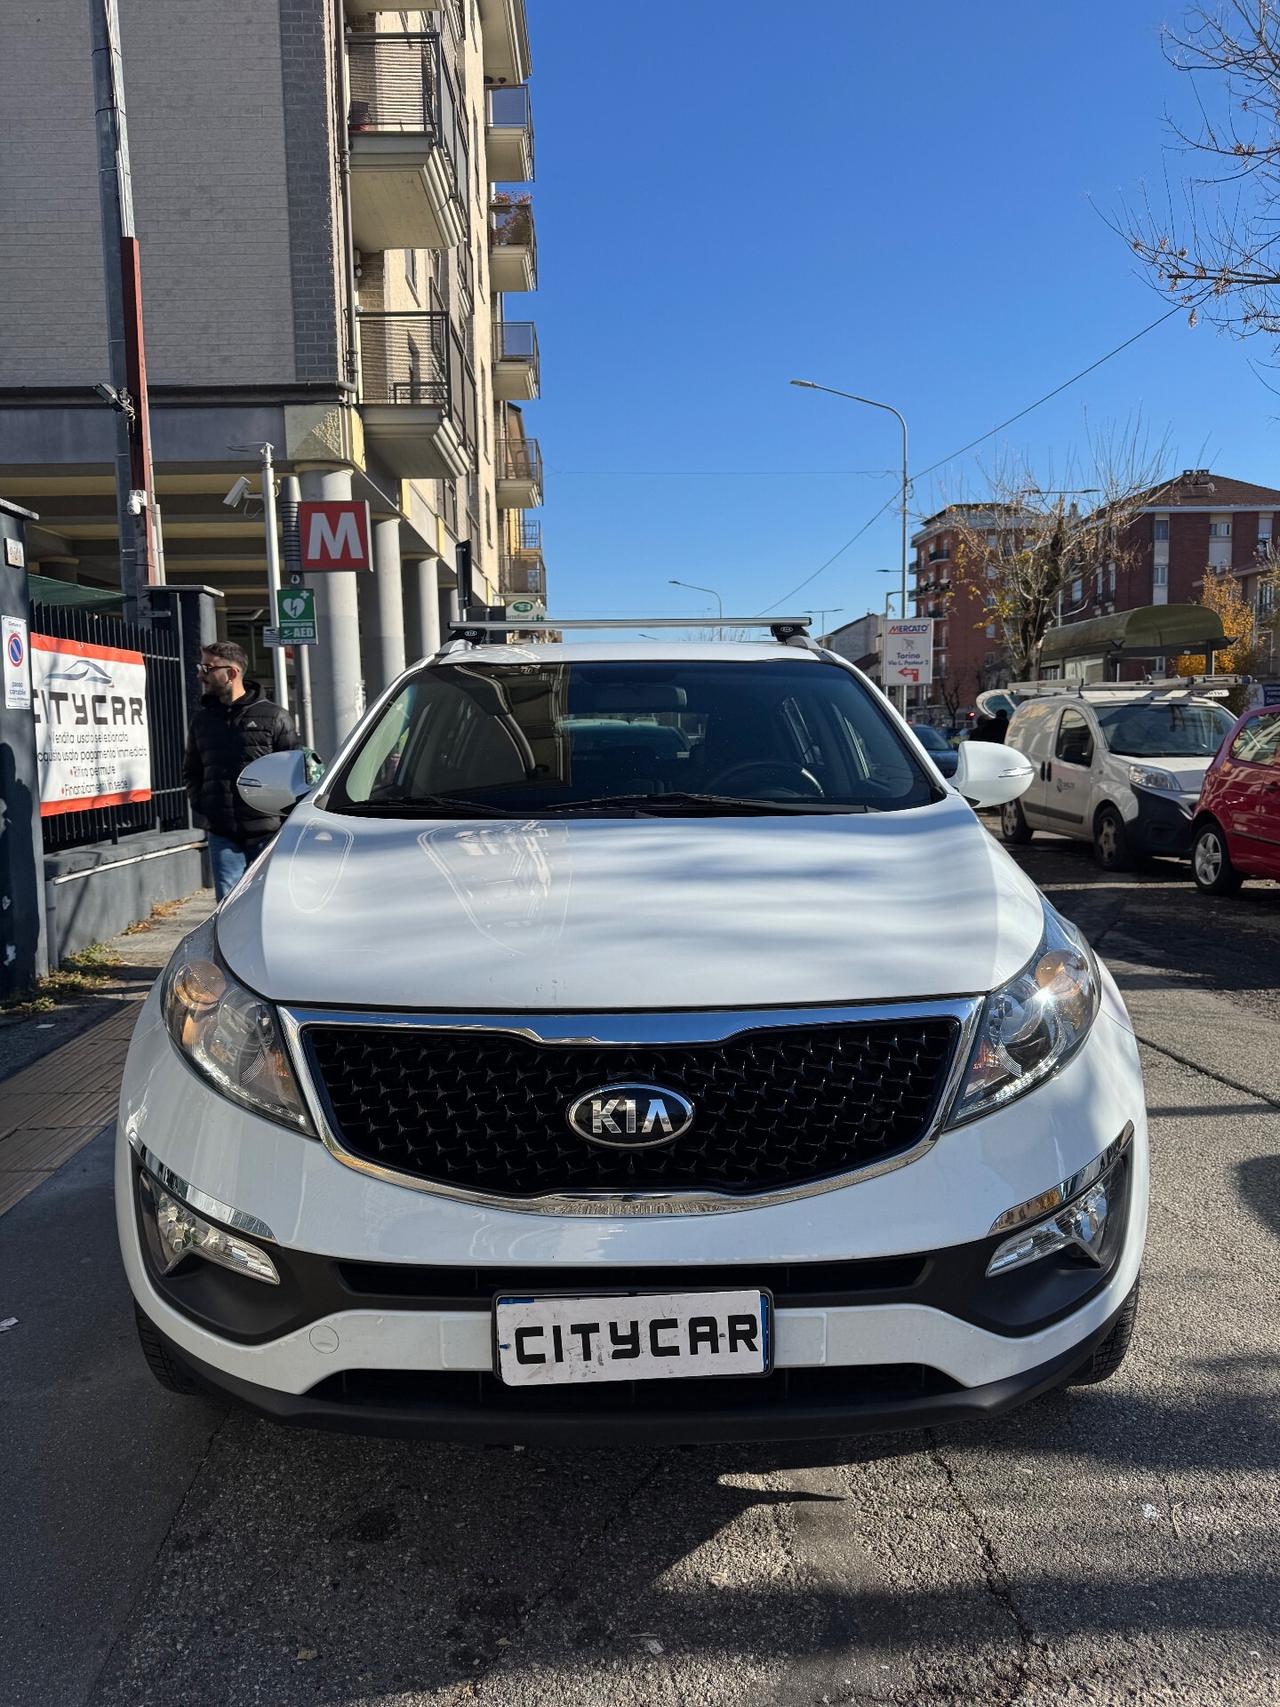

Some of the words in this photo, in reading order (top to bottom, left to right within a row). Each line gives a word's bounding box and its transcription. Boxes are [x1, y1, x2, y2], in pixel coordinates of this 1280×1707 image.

[307, 512, 363, 559] M
[293, 628, 313, 638] AED
[888, 624, 928, 634] MERCATO
[897, 651, 920, 659] Torino
[81, 749, 116, 763] pagamento
[117, 745, 148, 758] immediato
[90, 765, 116, 777] permute
[591, 1099, 674, 1133] KIA
[515, 1314, 759, 1364] CITYCAR
